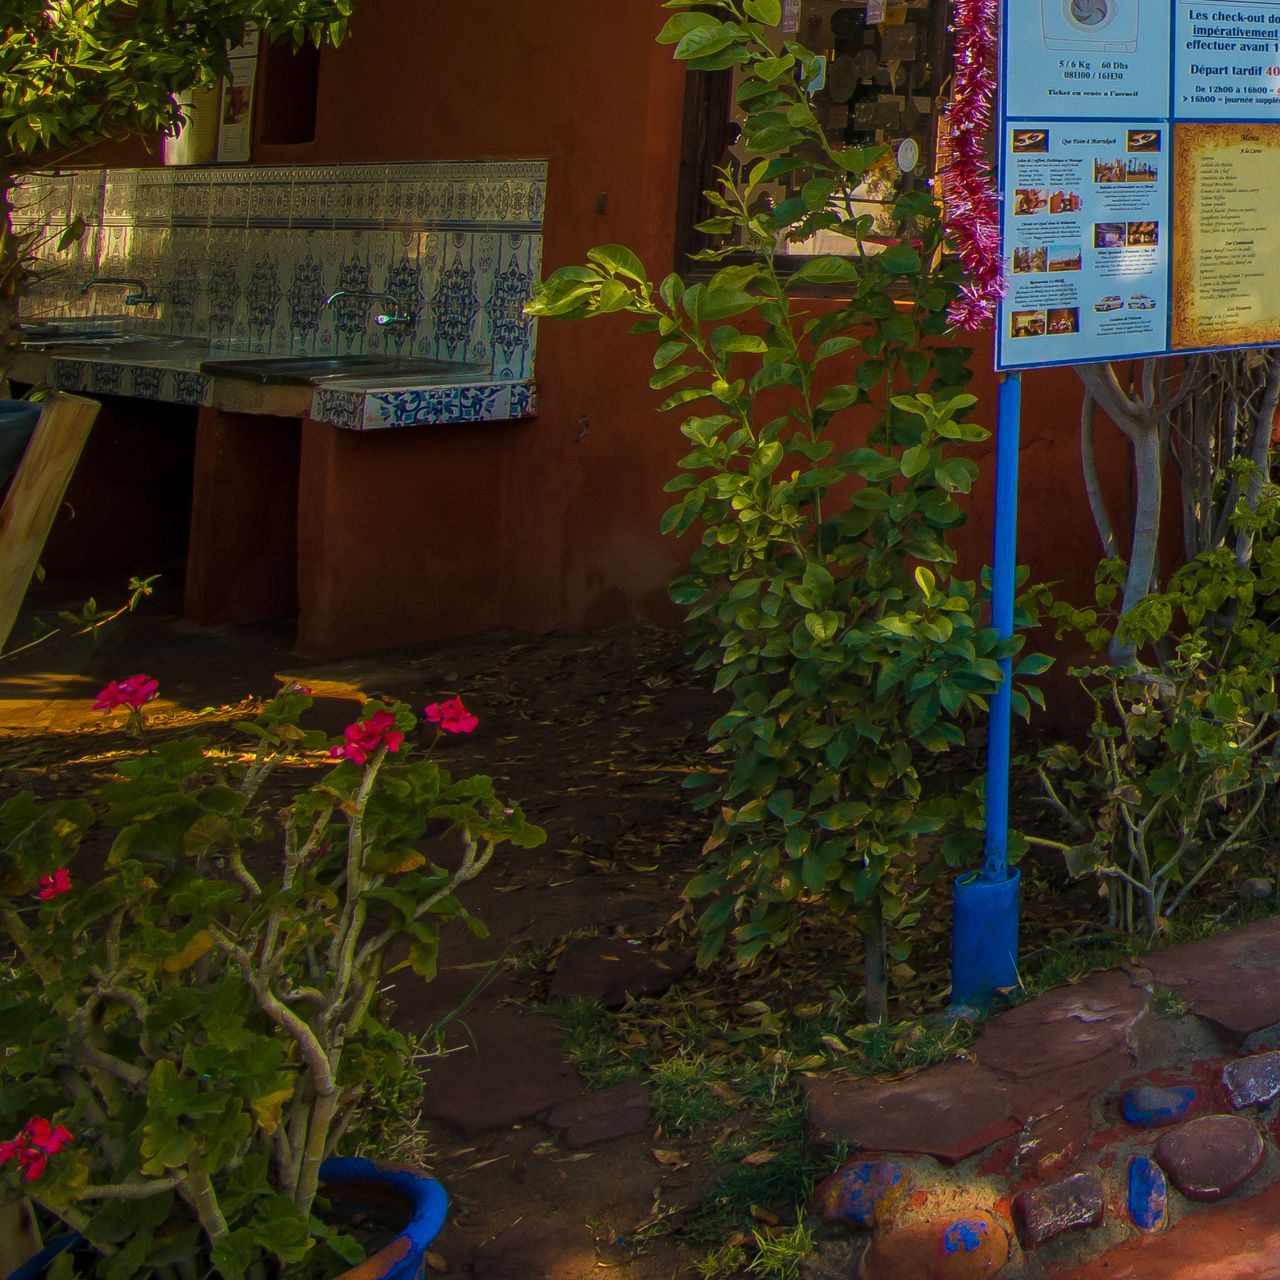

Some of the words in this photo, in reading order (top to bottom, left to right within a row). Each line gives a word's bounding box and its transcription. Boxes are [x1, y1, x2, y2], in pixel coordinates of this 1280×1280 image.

[1188, 10, 1208, 21] Les
[1212, 11, 1265, 24] check-out
[1193, 25, 1279, 38] impérativement
[1186, 40, 1237, 51] effectuer
[1240, 43, 1270, 52] avant
[1058, 60, 1064, 68] 5
[1078, 61, 1091, 70] Kg
[1113, 62, 1129, 70] Dhs
[1190, 64, 1229, 76] Départ
[1232, 66, 1263, 76] tardif
[1266, 67, 1280, 76] 40
[1064, 72, 1091, 80] 08H00
[1098, 72, 1124, 80] 16H30
[1190, 95, 1216, 103] 16h00
[1224, 96, 1253, 104] journée
